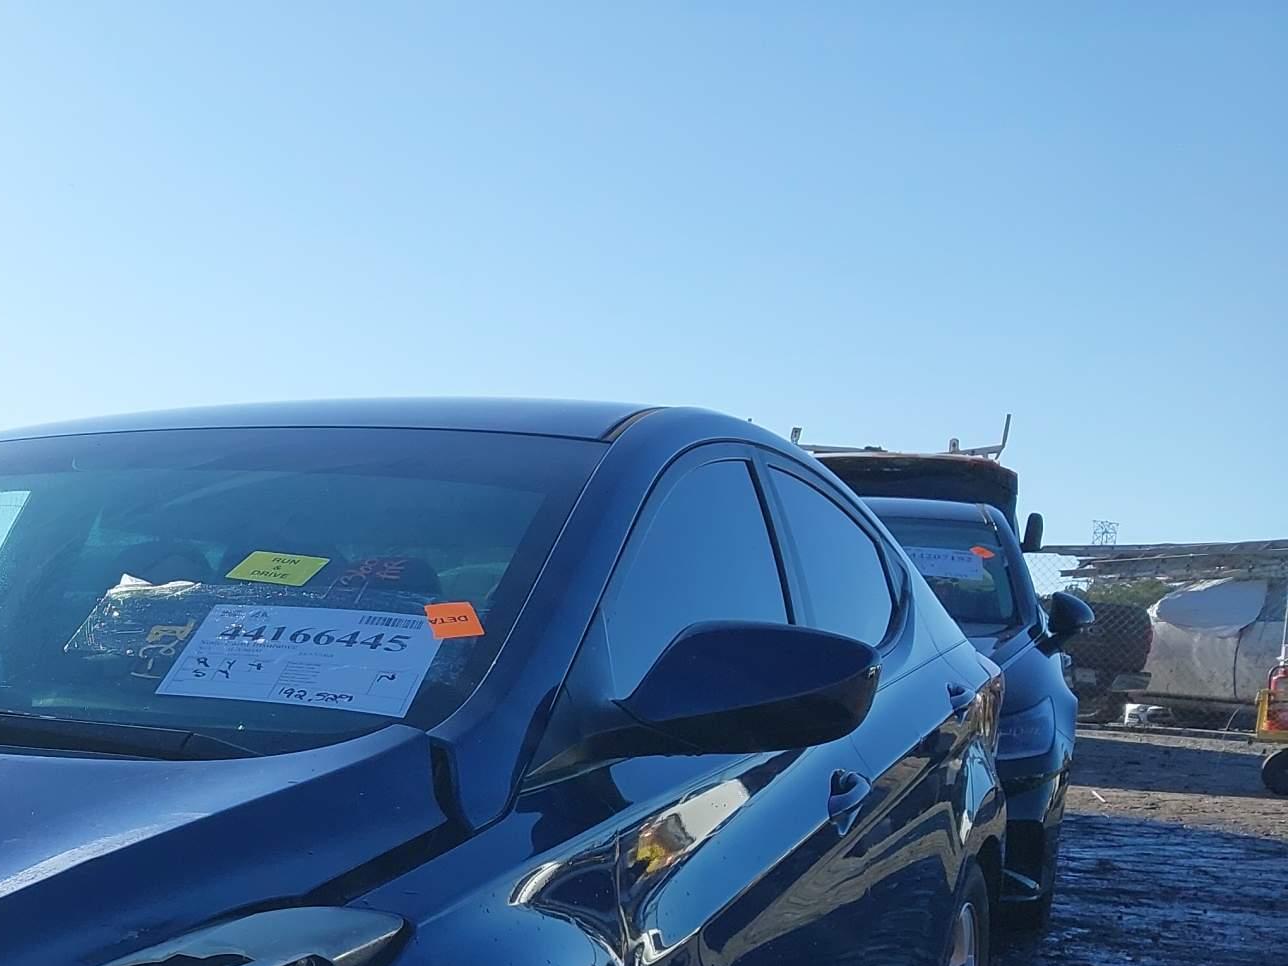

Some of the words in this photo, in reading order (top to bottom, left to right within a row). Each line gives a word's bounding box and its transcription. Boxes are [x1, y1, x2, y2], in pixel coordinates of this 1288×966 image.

[272, 557, 301, 565] RUN
[250, 569, 289, 579] DRIVE
[219, 626, 410, 652] 44166445
